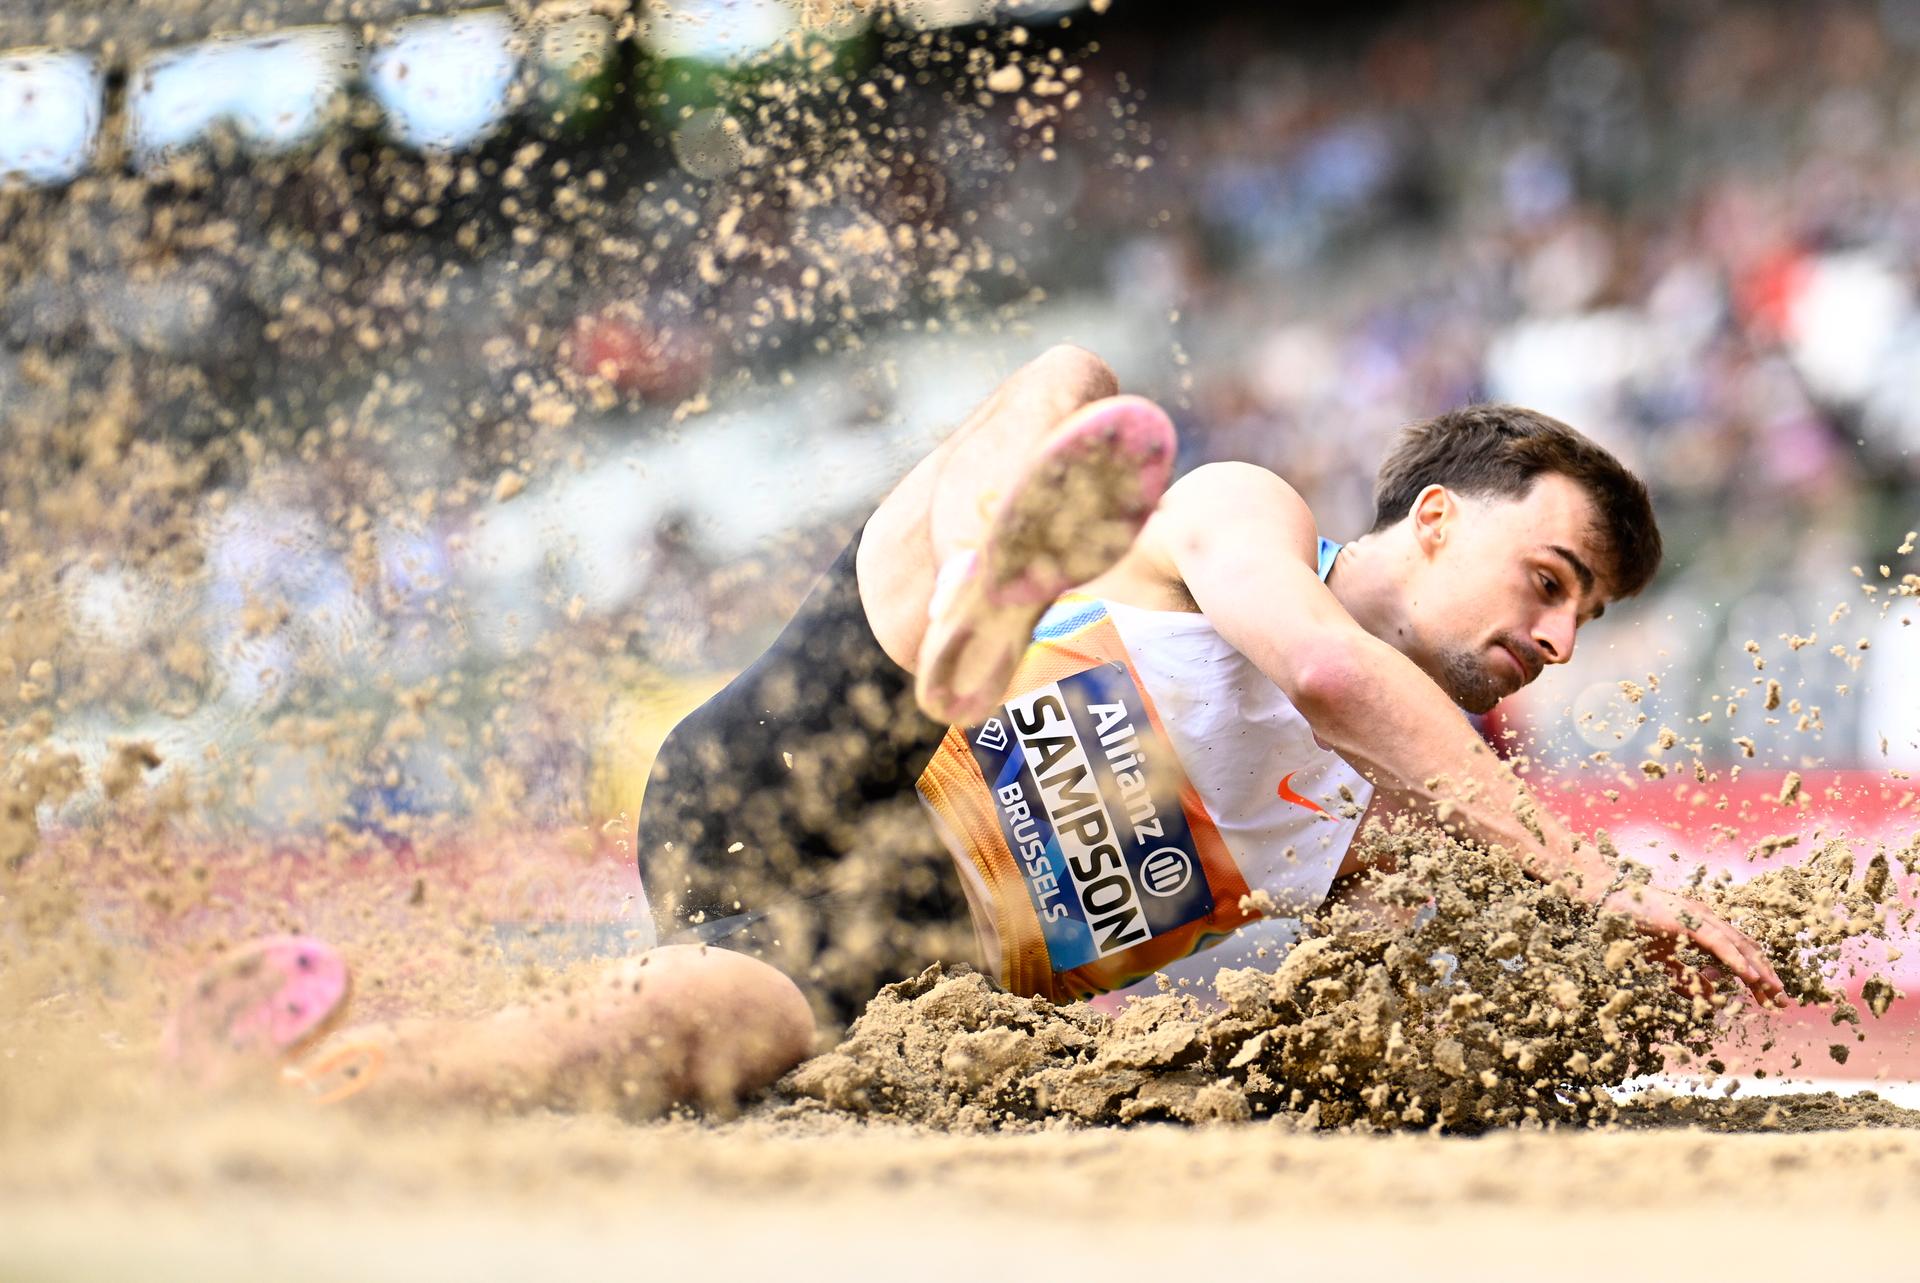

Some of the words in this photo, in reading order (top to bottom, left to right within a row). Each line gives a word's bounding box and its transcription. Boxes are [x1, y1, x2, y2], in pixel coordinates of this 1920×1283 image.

[1012, 695, 1147, 954] SAMPSON
[1086, 699, 1164, 845] Allianz
[997, 782, 1068, 923] BRUSSELS
